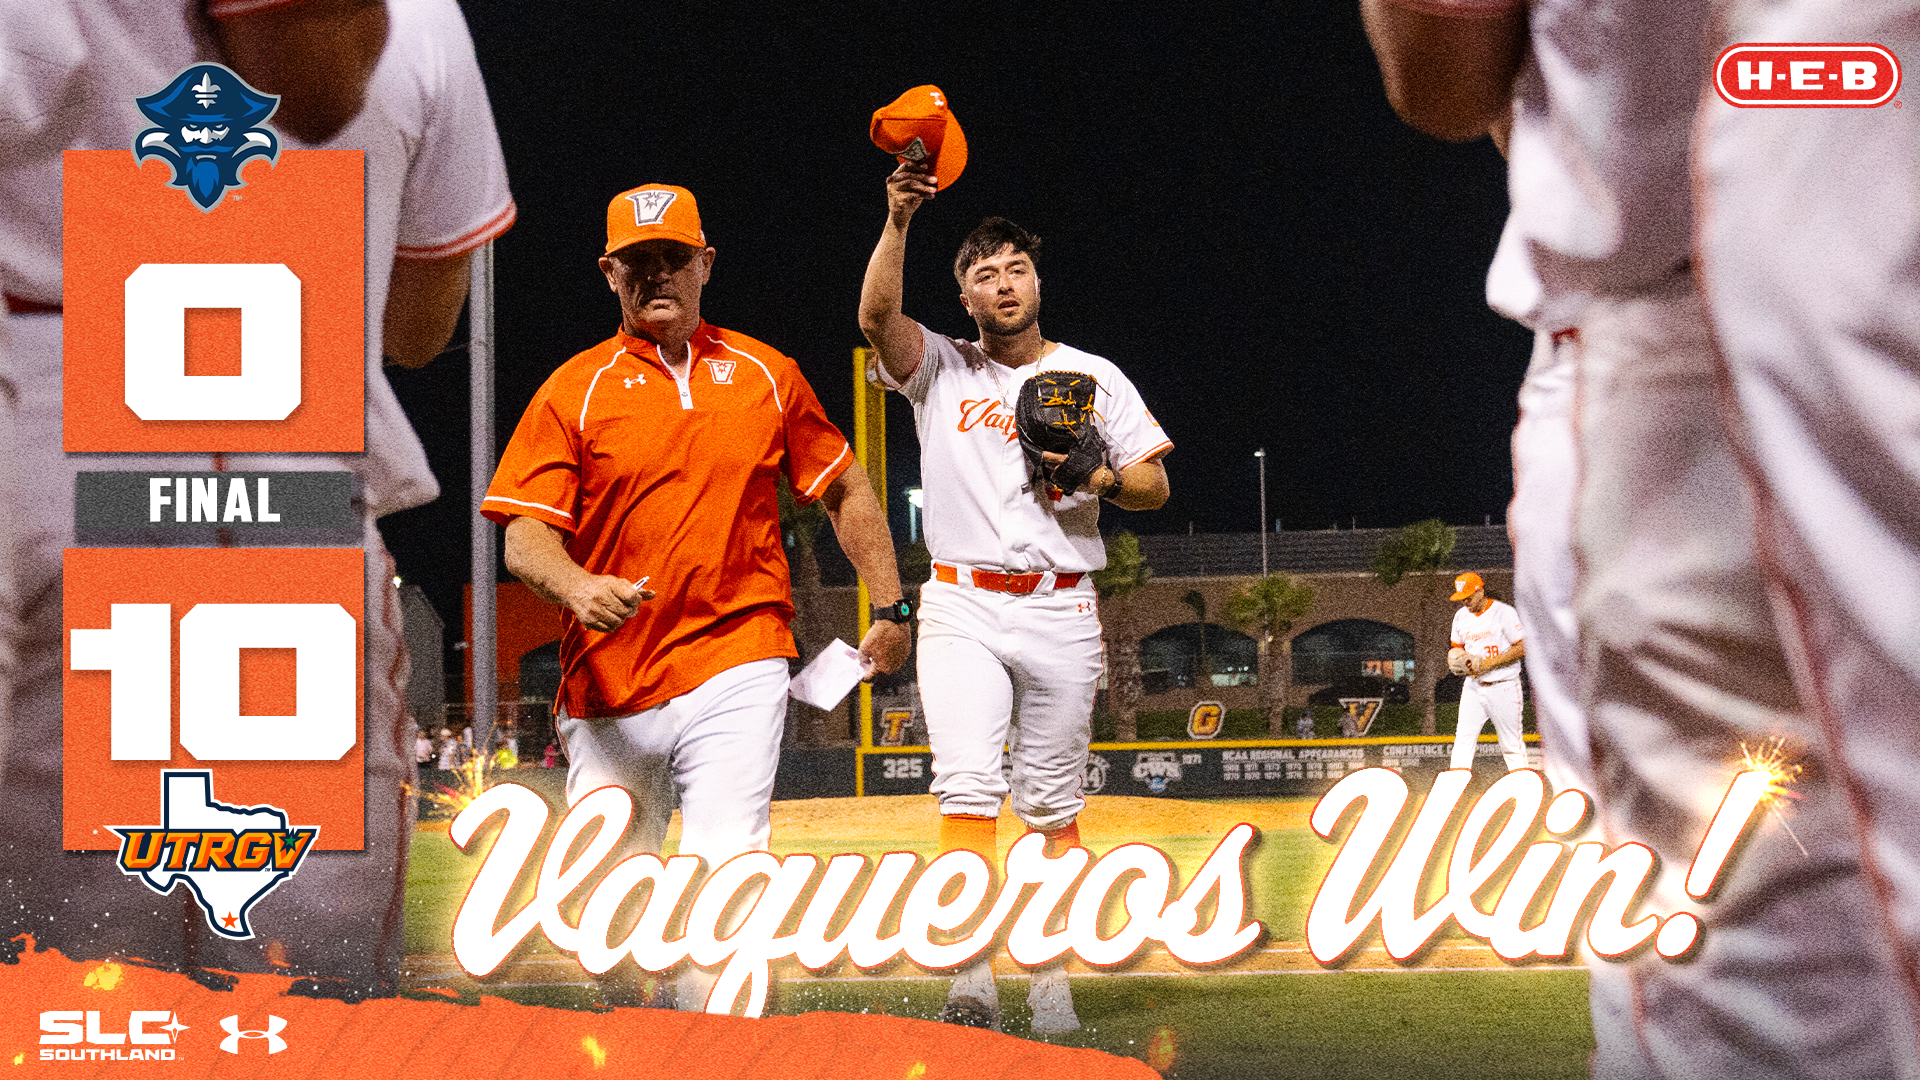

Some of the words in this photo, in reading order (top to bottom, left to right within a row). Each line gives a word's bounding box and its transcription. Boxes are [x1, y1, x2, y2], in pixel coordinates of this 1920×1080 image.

[1483, 645, 1499, 659] 38
[880, 706, 914, 746] T
[1187, 701, 1225, 740] G
[1338, 698, 1384, 736] V
[1222, 750, 1249, 760] NCAA
[1249, 749, 1296, 760] REGIONAL
[1298, 748, 1365, 759] APPEARANCES
[1383, 745, 1443, 757] CONFERENCE
[883, 758, 923, 779] 325
